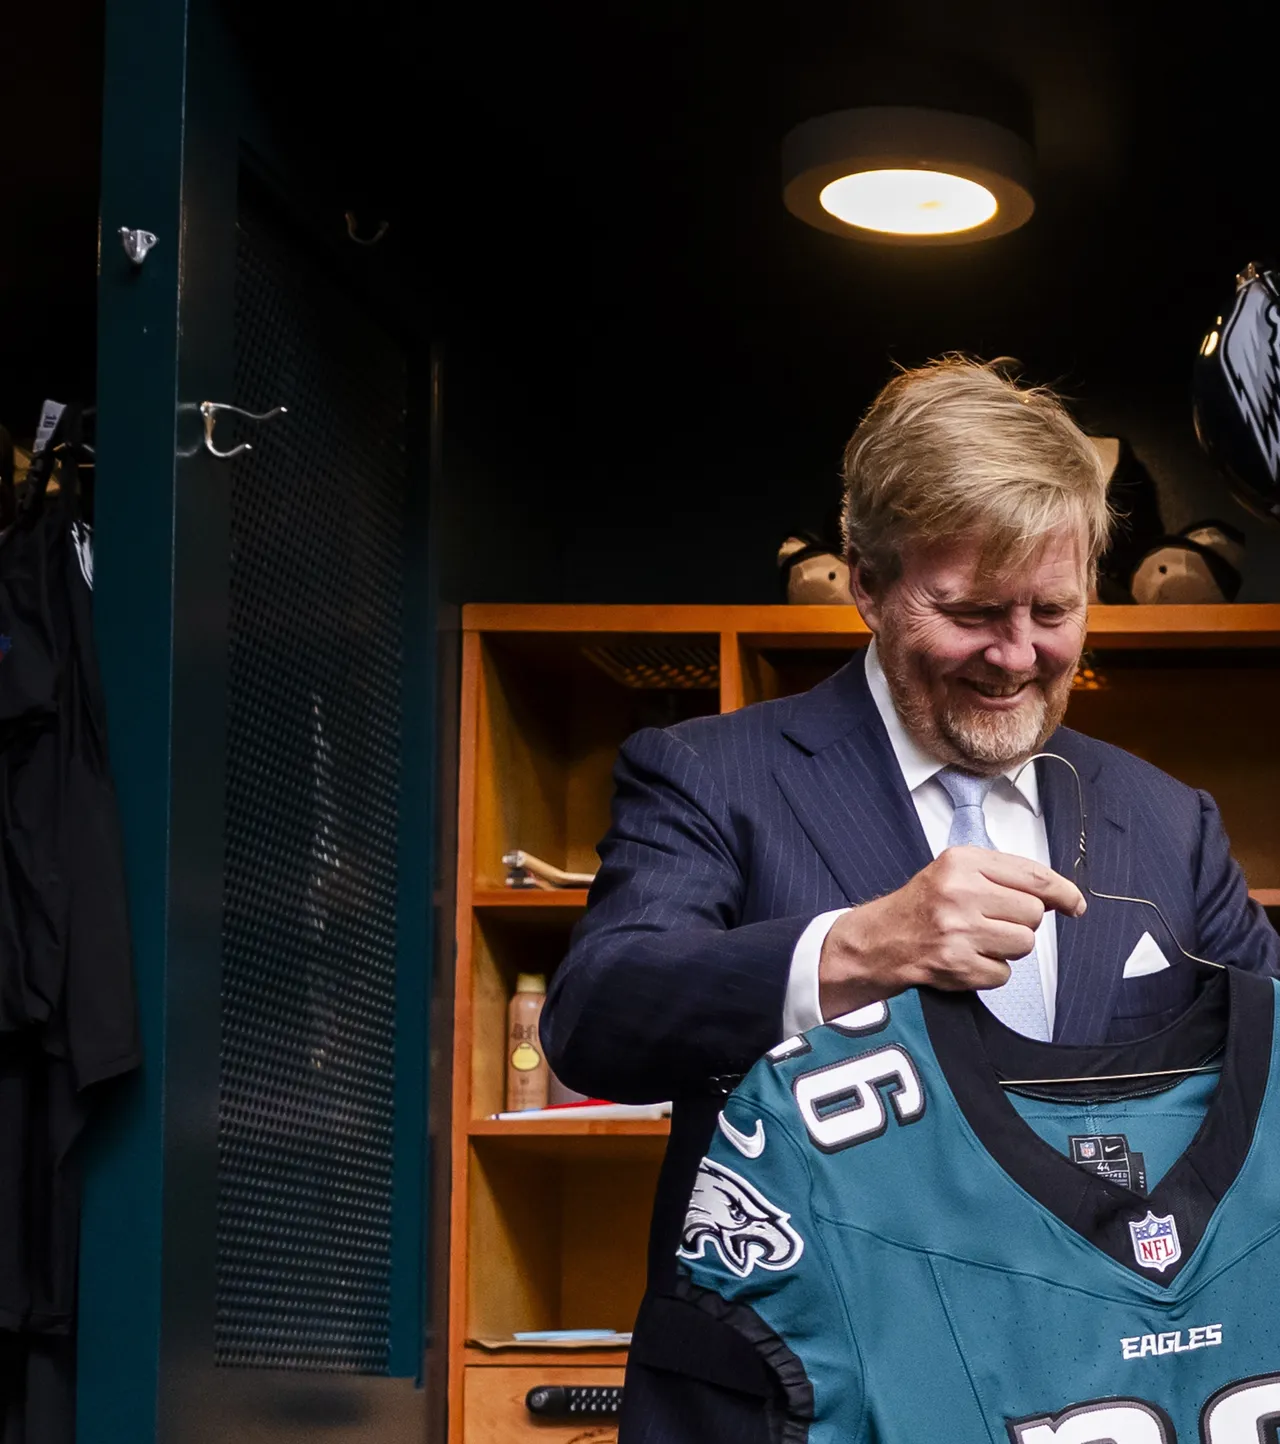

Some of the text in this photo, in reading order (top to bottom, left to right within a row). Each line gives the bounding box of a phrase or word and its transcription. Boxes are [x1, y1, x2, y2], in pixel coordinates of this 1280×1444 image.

[1097, 1163, 1110, 1171] 44
[1140, 1237, 1174, 1261] NFL
[1120, 1324, 1223, 1359] EAGLES
